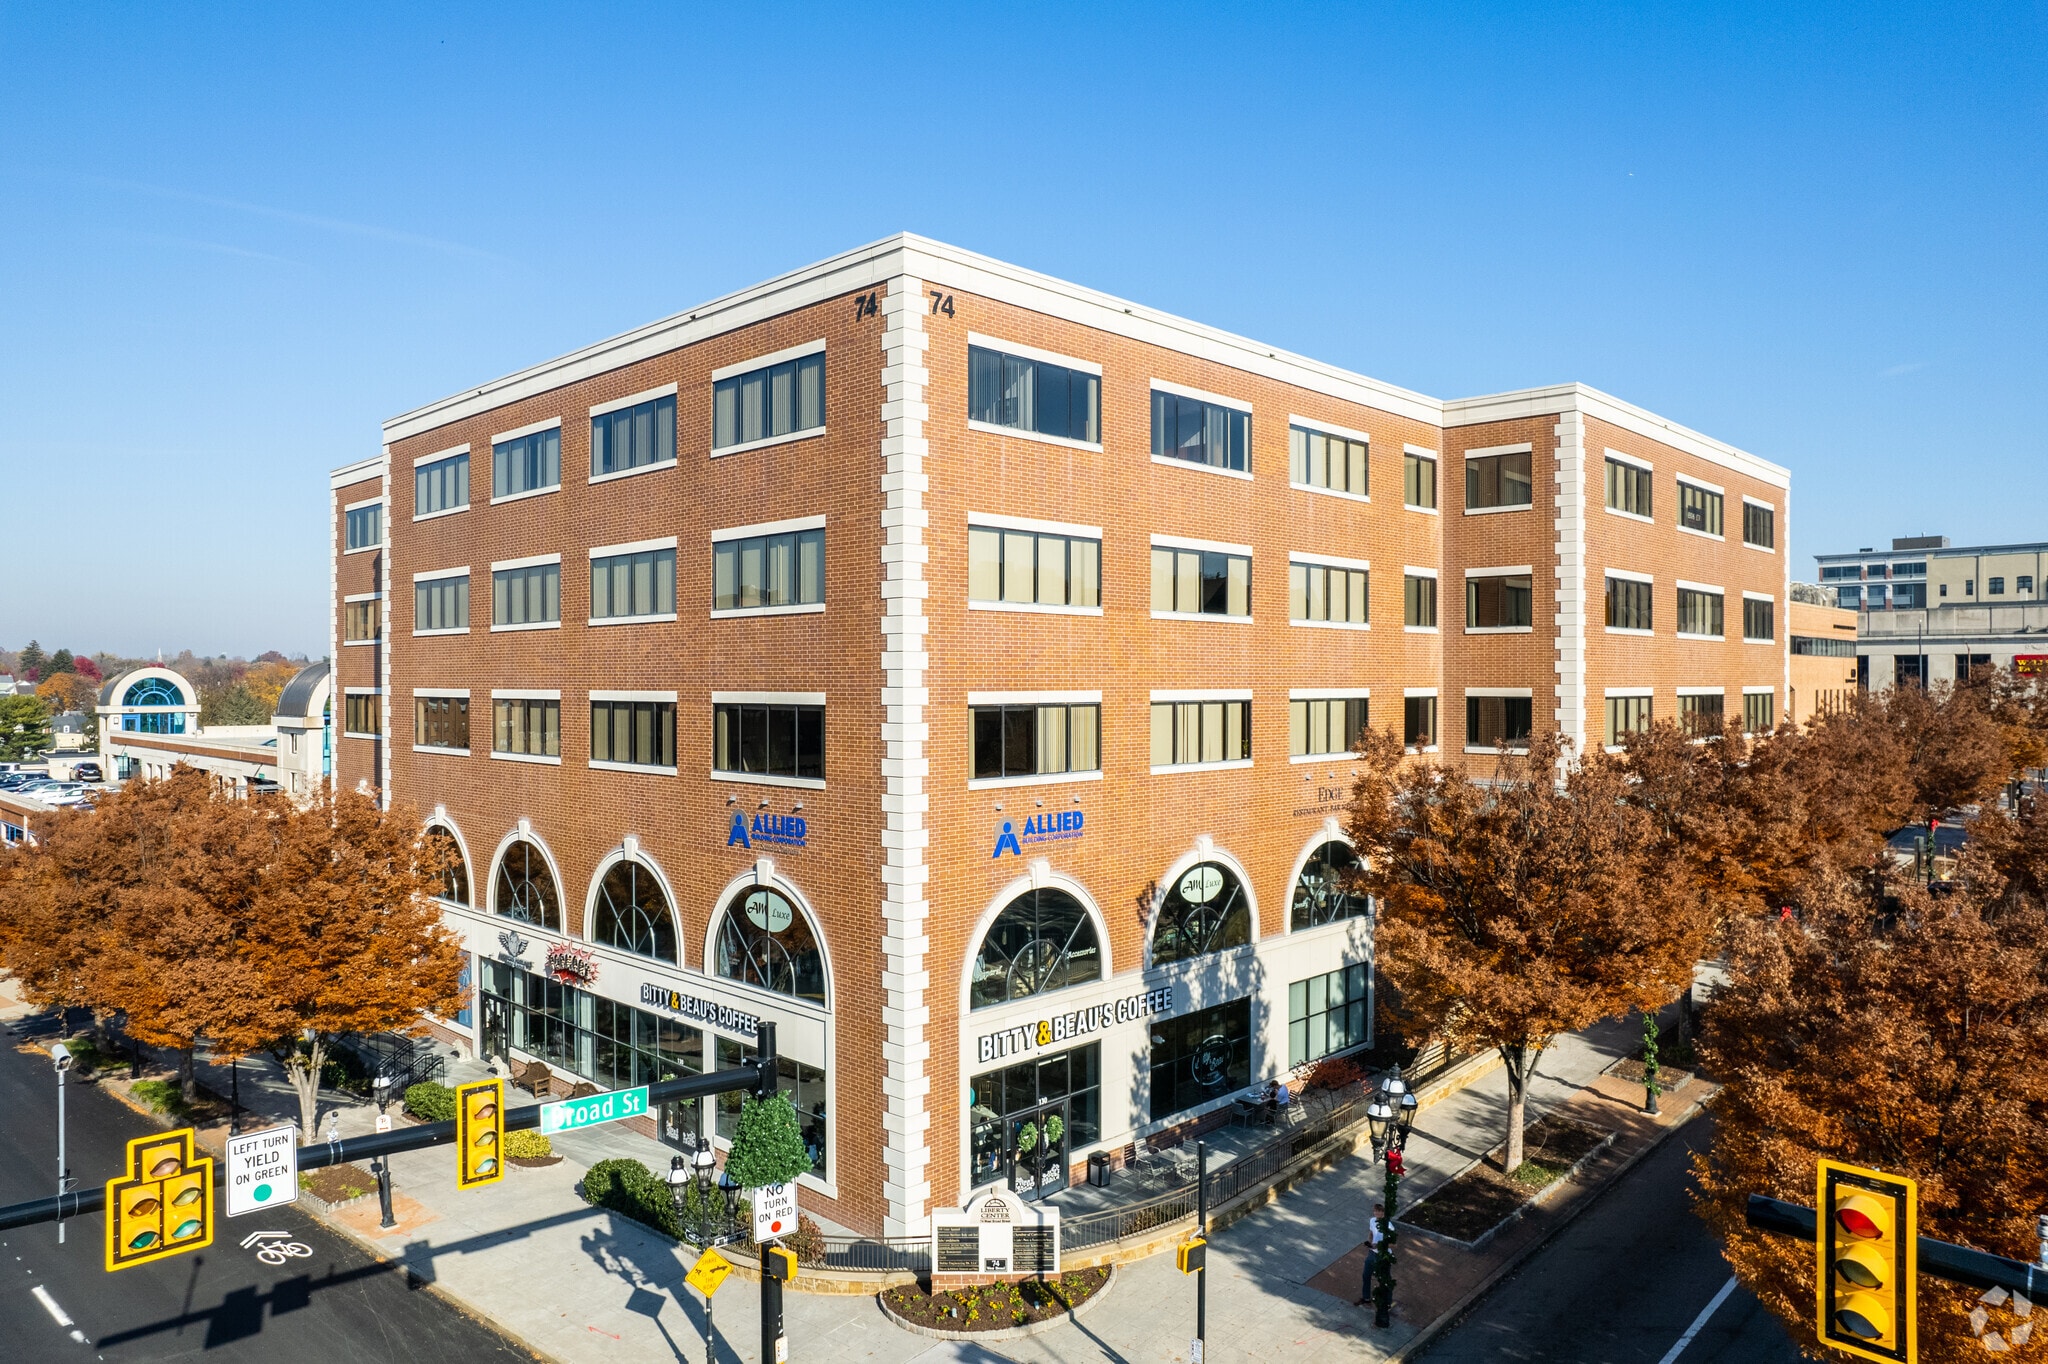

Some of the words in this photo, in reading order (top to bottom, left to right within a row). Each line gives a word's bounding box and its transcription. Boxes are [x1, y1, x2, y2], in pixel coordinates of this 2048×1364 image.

[855, 291, 878, 322] 74
[930, 290, 955, 318] 74
[752, 813, 806, 838] ALLIED
[1023, 811, 1084, 836] ALLIED
[771, 908, 790, 920] Luxe
[643, 983, 671, 1006] BITTY
[718, 1005, 759, 1034] COFFEE
[979, 1023, 1036, 1063] BITTY
[1116, 986, 1172, 1024] COFFEE
[551, 1095, 614, 1129] Broad
[622, 1092, 640, 1114] St
[233, 1140, 259, 1155] LEFT
[262, 1134, 288, 1148] TURN
[244, 1150, 280, 1169] YIELD
[235, 1173, 250, 1186] ON
[254, 1164, 288, 1181] GREEN
[766, 1184, 784, 1198] NO
[764, 1196, 788, 1210] TURN
[758, 1212, 771, 1223] ON
[775, 1206, 793, 1218] RED
[701, 1257, 717, 1266] SHARE
[991, 1259, 1001, 1267] 74
